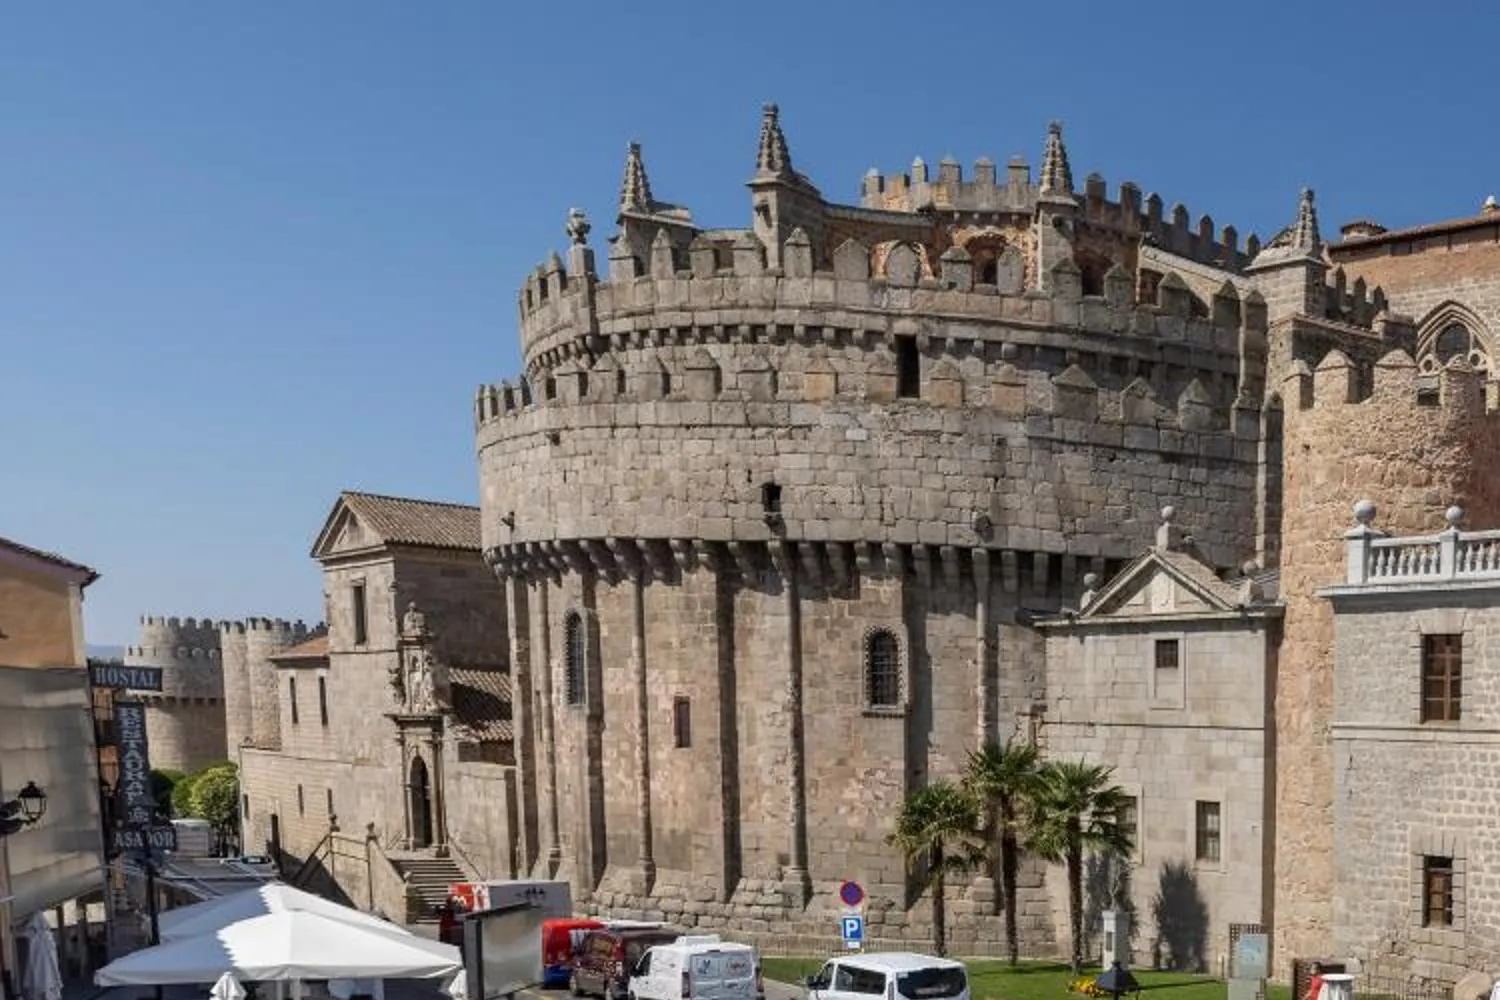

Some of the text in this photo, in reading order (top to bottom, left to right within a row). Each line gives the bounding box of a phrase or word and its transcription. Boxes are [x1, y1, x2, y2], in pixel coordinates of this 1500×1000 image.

[95, 667, 159, 688] HOSTAL
[120, 706, 149, 823] RESTAURA
[845, 919, 859, 937] P
